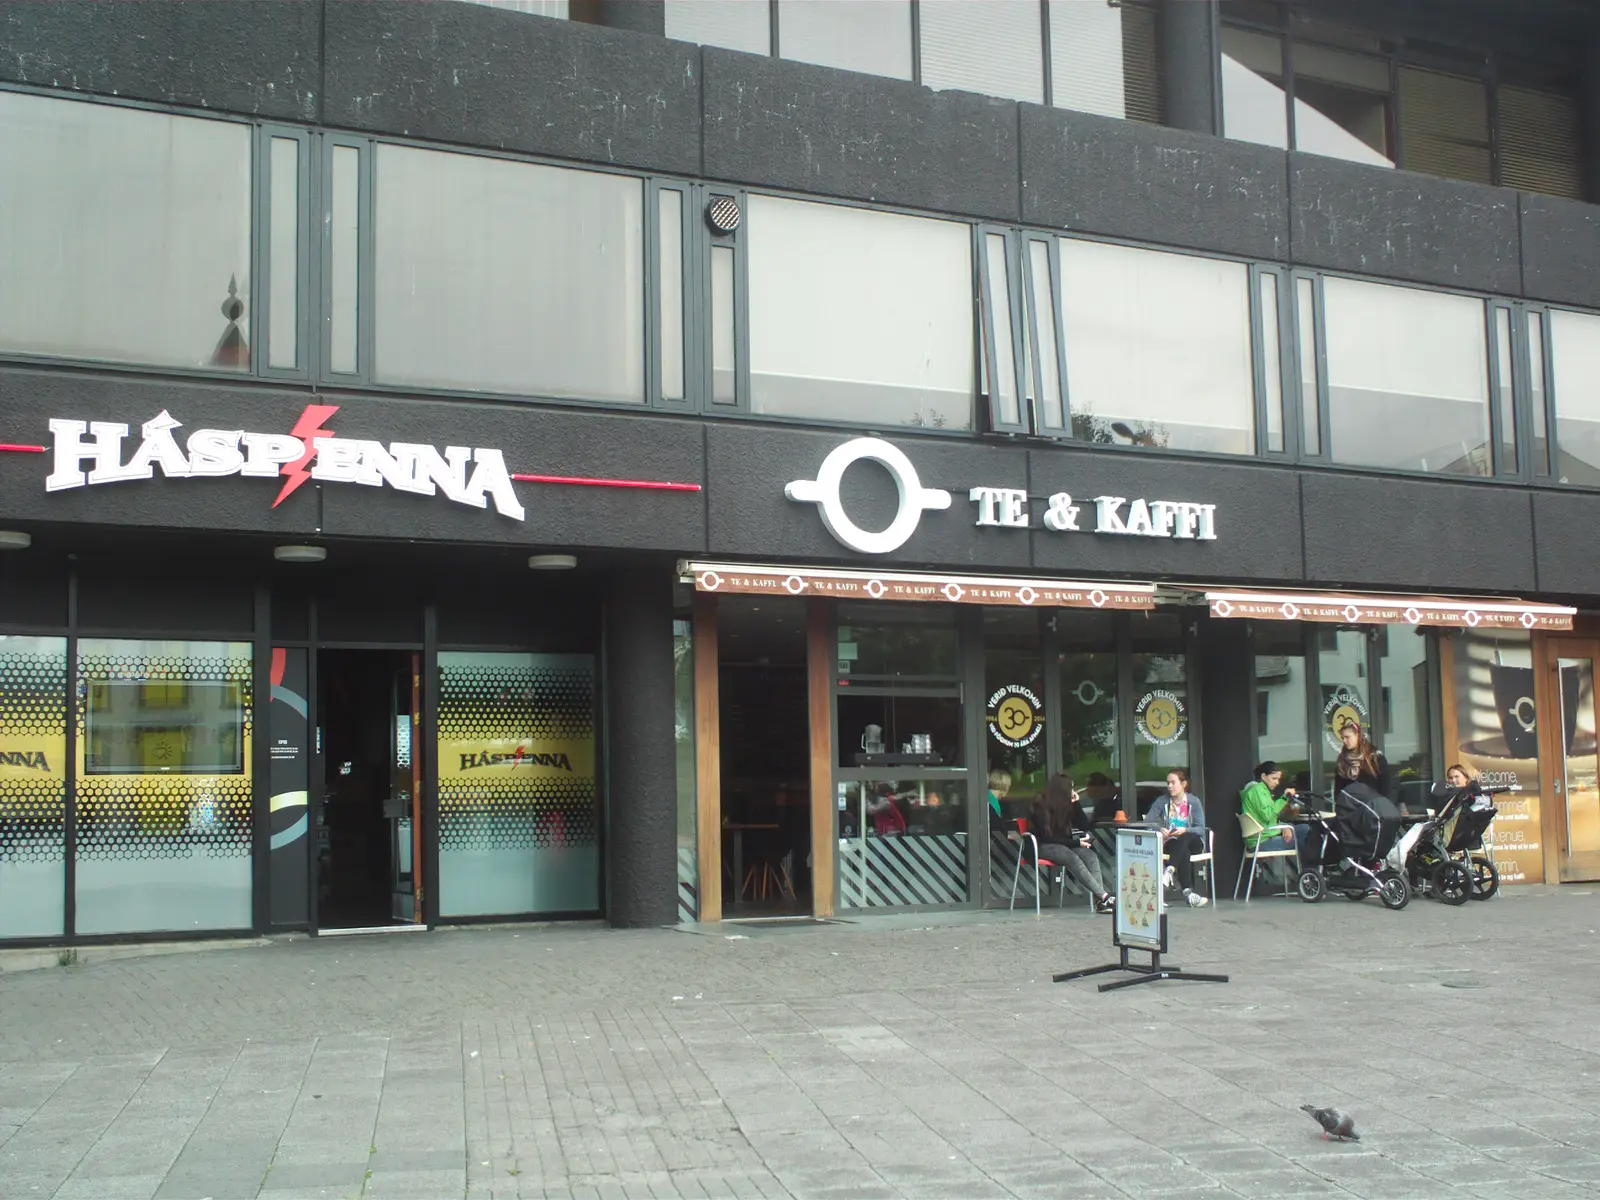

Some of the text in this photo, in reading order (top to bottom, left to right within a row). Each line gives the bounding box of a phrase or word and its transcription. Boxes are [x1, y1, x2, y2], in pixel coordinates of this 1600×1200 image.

[45, 409, 525, 521] HÁSPENNA
[969, 487, 1217, 539] TE & KAFFI
[836, 583, 858, 591] KAFFI
[915, 587, 936, 595] KAFFI
[459, 750, 572, 772] HÁSPENNA
